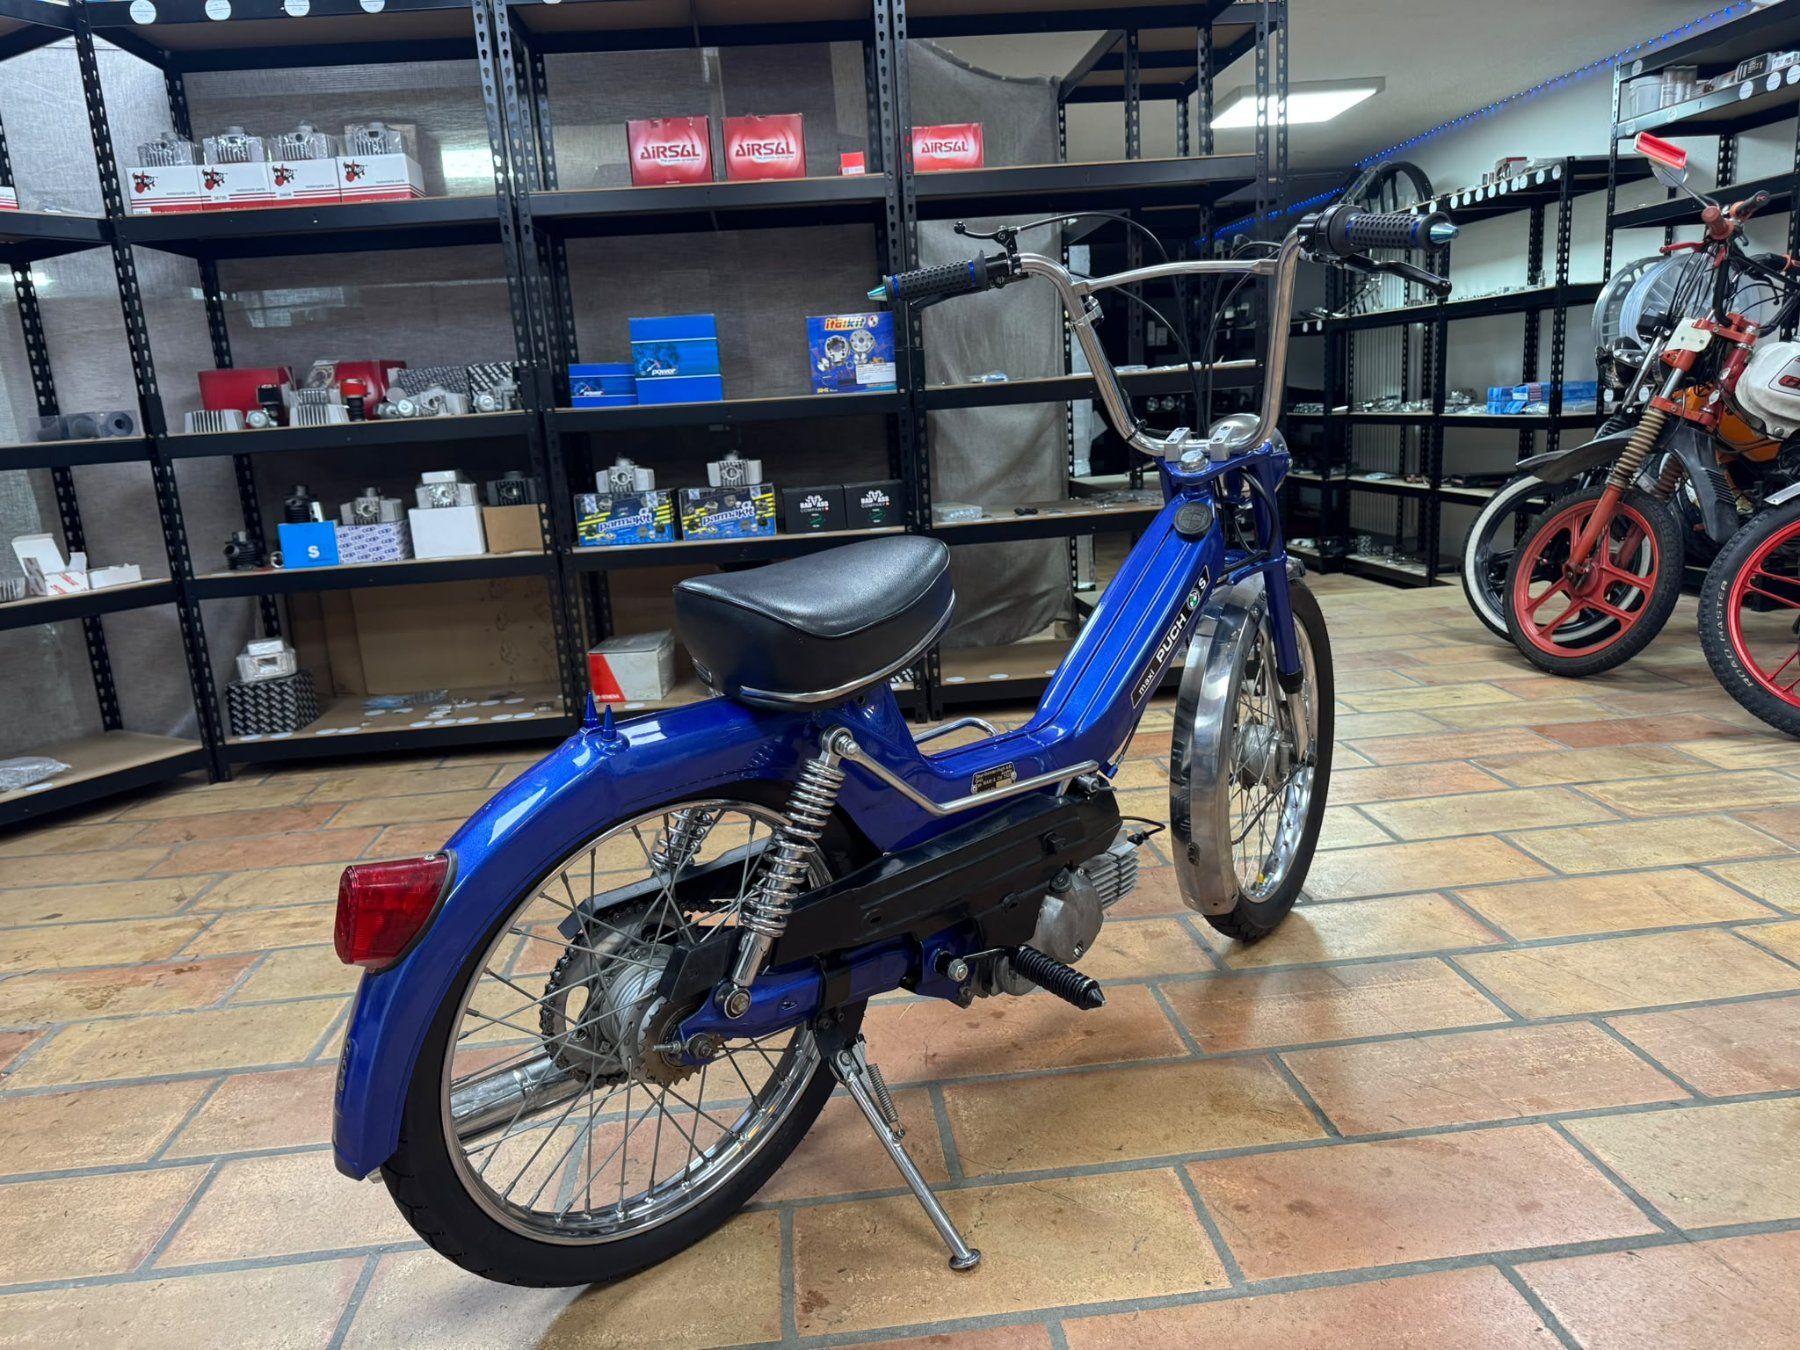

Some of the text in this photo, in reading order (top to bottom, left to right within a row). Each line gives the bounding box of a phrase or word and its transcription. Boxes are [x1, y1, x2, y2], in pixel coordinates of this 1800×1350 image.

[308, 545, 320, 558] S
[1138, 578, 1206, 695] maxi PUCH S
[1716, 580, 1754, 687] ROAD MASTER
